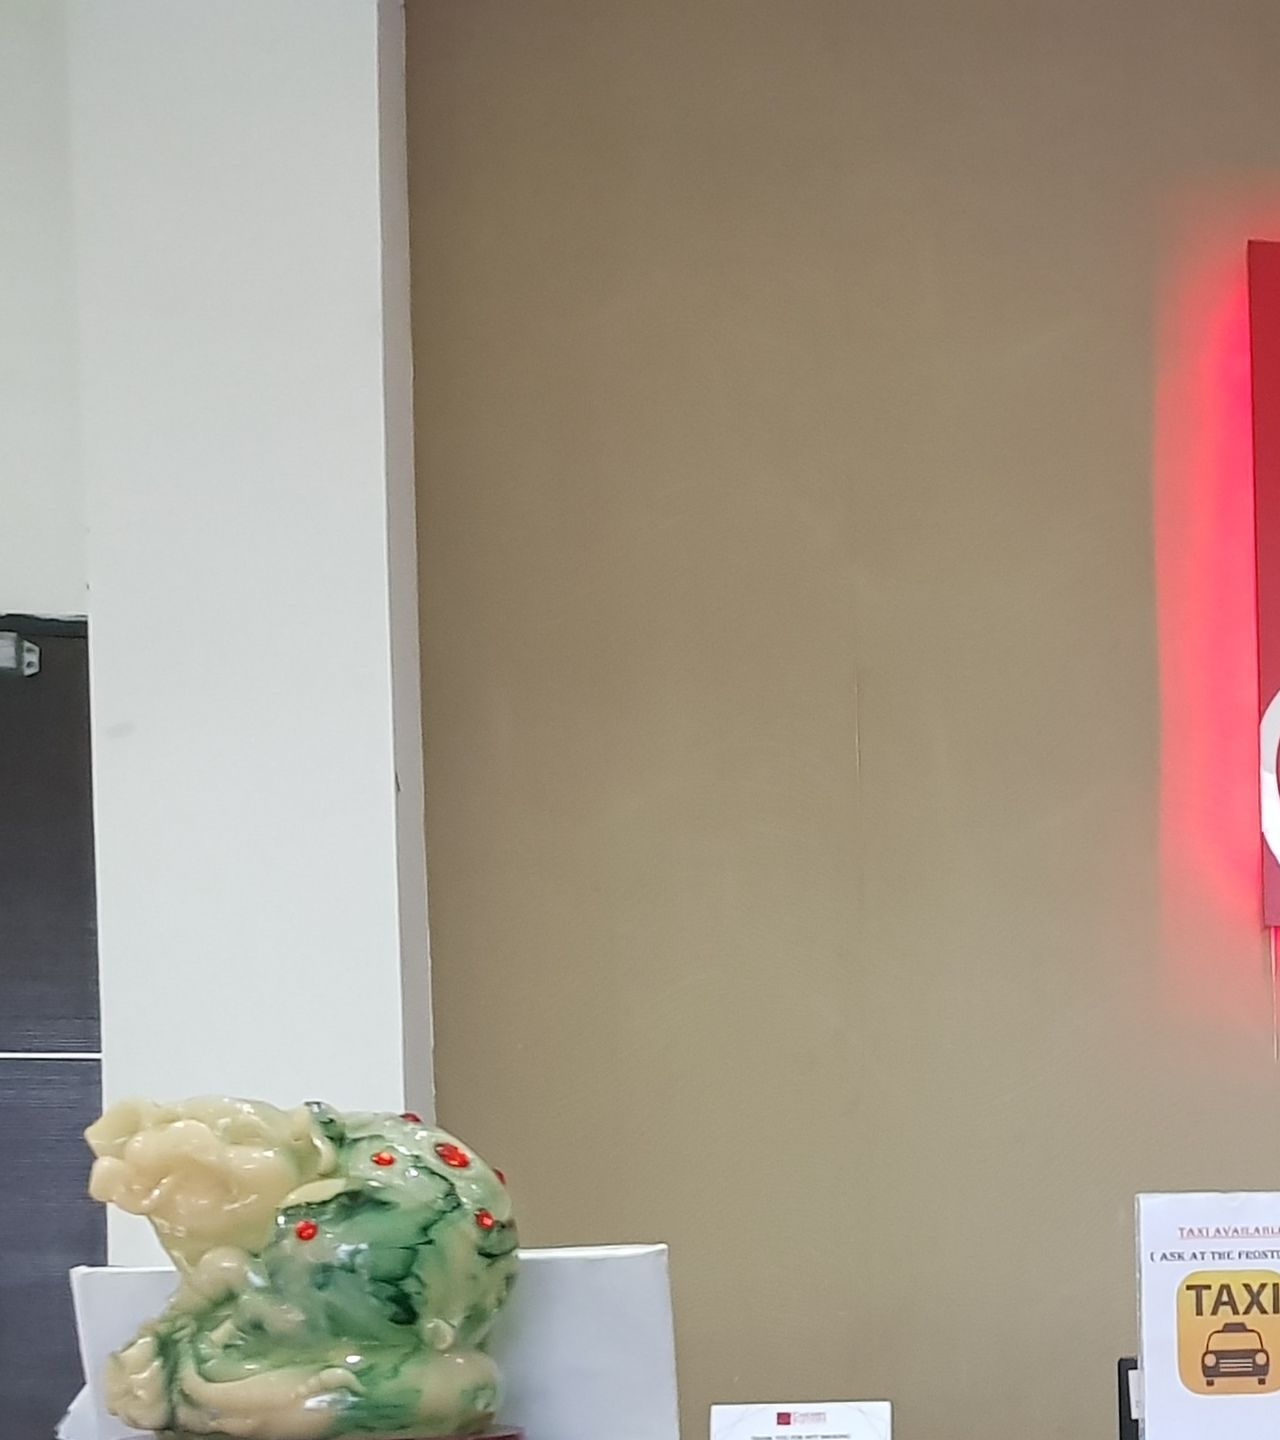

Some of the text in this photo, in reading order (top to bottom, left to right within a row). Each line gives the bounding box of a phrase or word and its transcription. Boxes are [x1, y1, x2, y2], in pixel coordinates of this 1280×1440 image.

[1178, 1226, 1209, 1239] TAXI
[1160, 1252, 1185, 1262] ASK
[1189, 1251, 1209, 1261] AT
[1211, 1251, 1235, 1261] THE
[1186, 1283, 1280, 1316] TAXI
